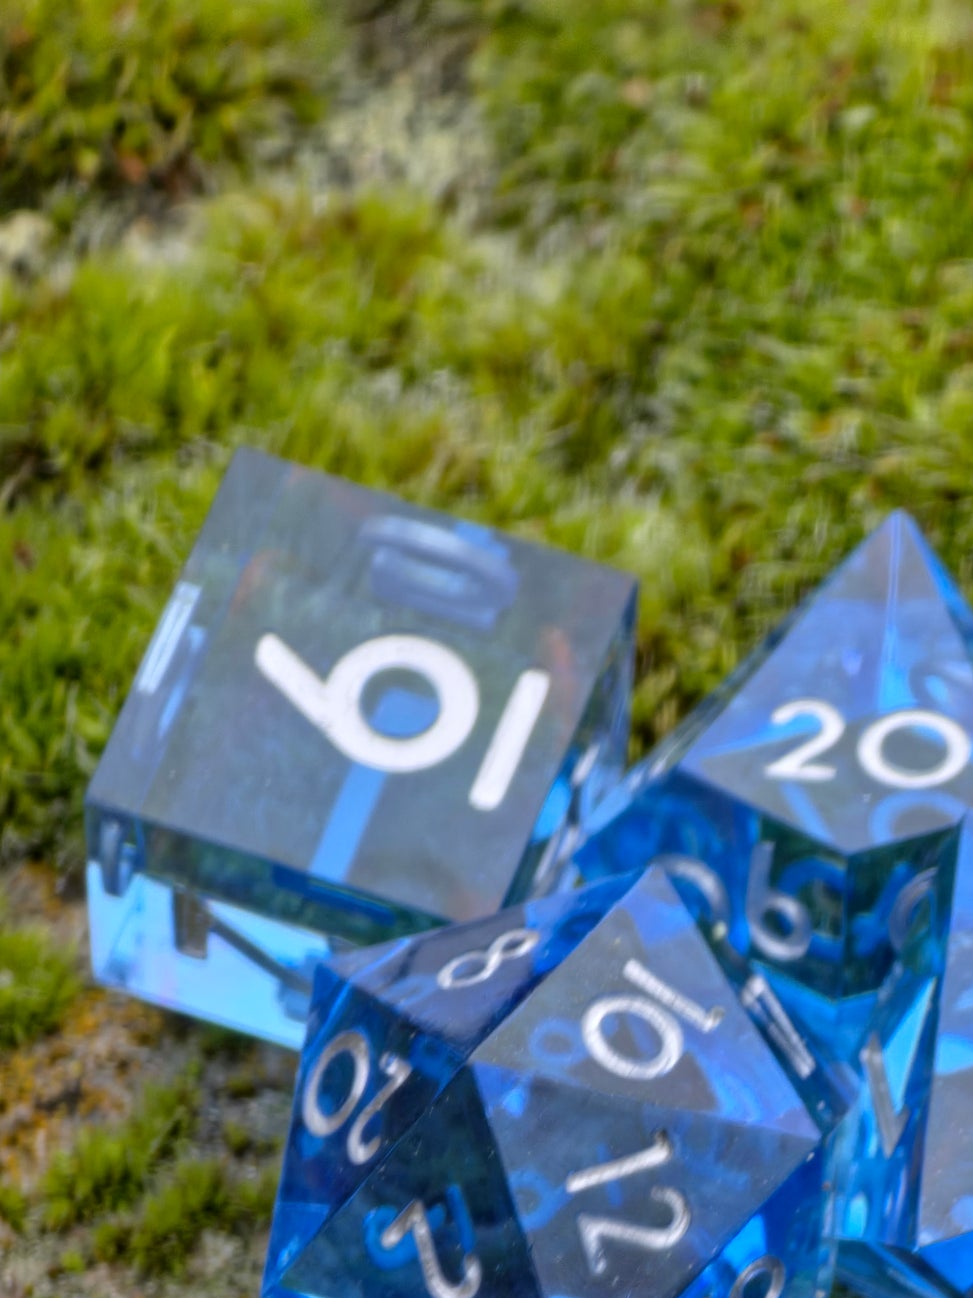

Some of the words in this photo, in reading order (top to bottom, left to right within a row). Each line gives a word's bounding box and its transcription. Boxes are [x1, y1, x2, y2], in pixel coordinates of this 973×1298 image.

[765, 700, 972, 790] 20
[438, 928, 539, 990] 8
[581, 957, 725, 1081] 10
[302, 1029, 413, 1166] 20
[563, 1128, 692, 1276] 12
